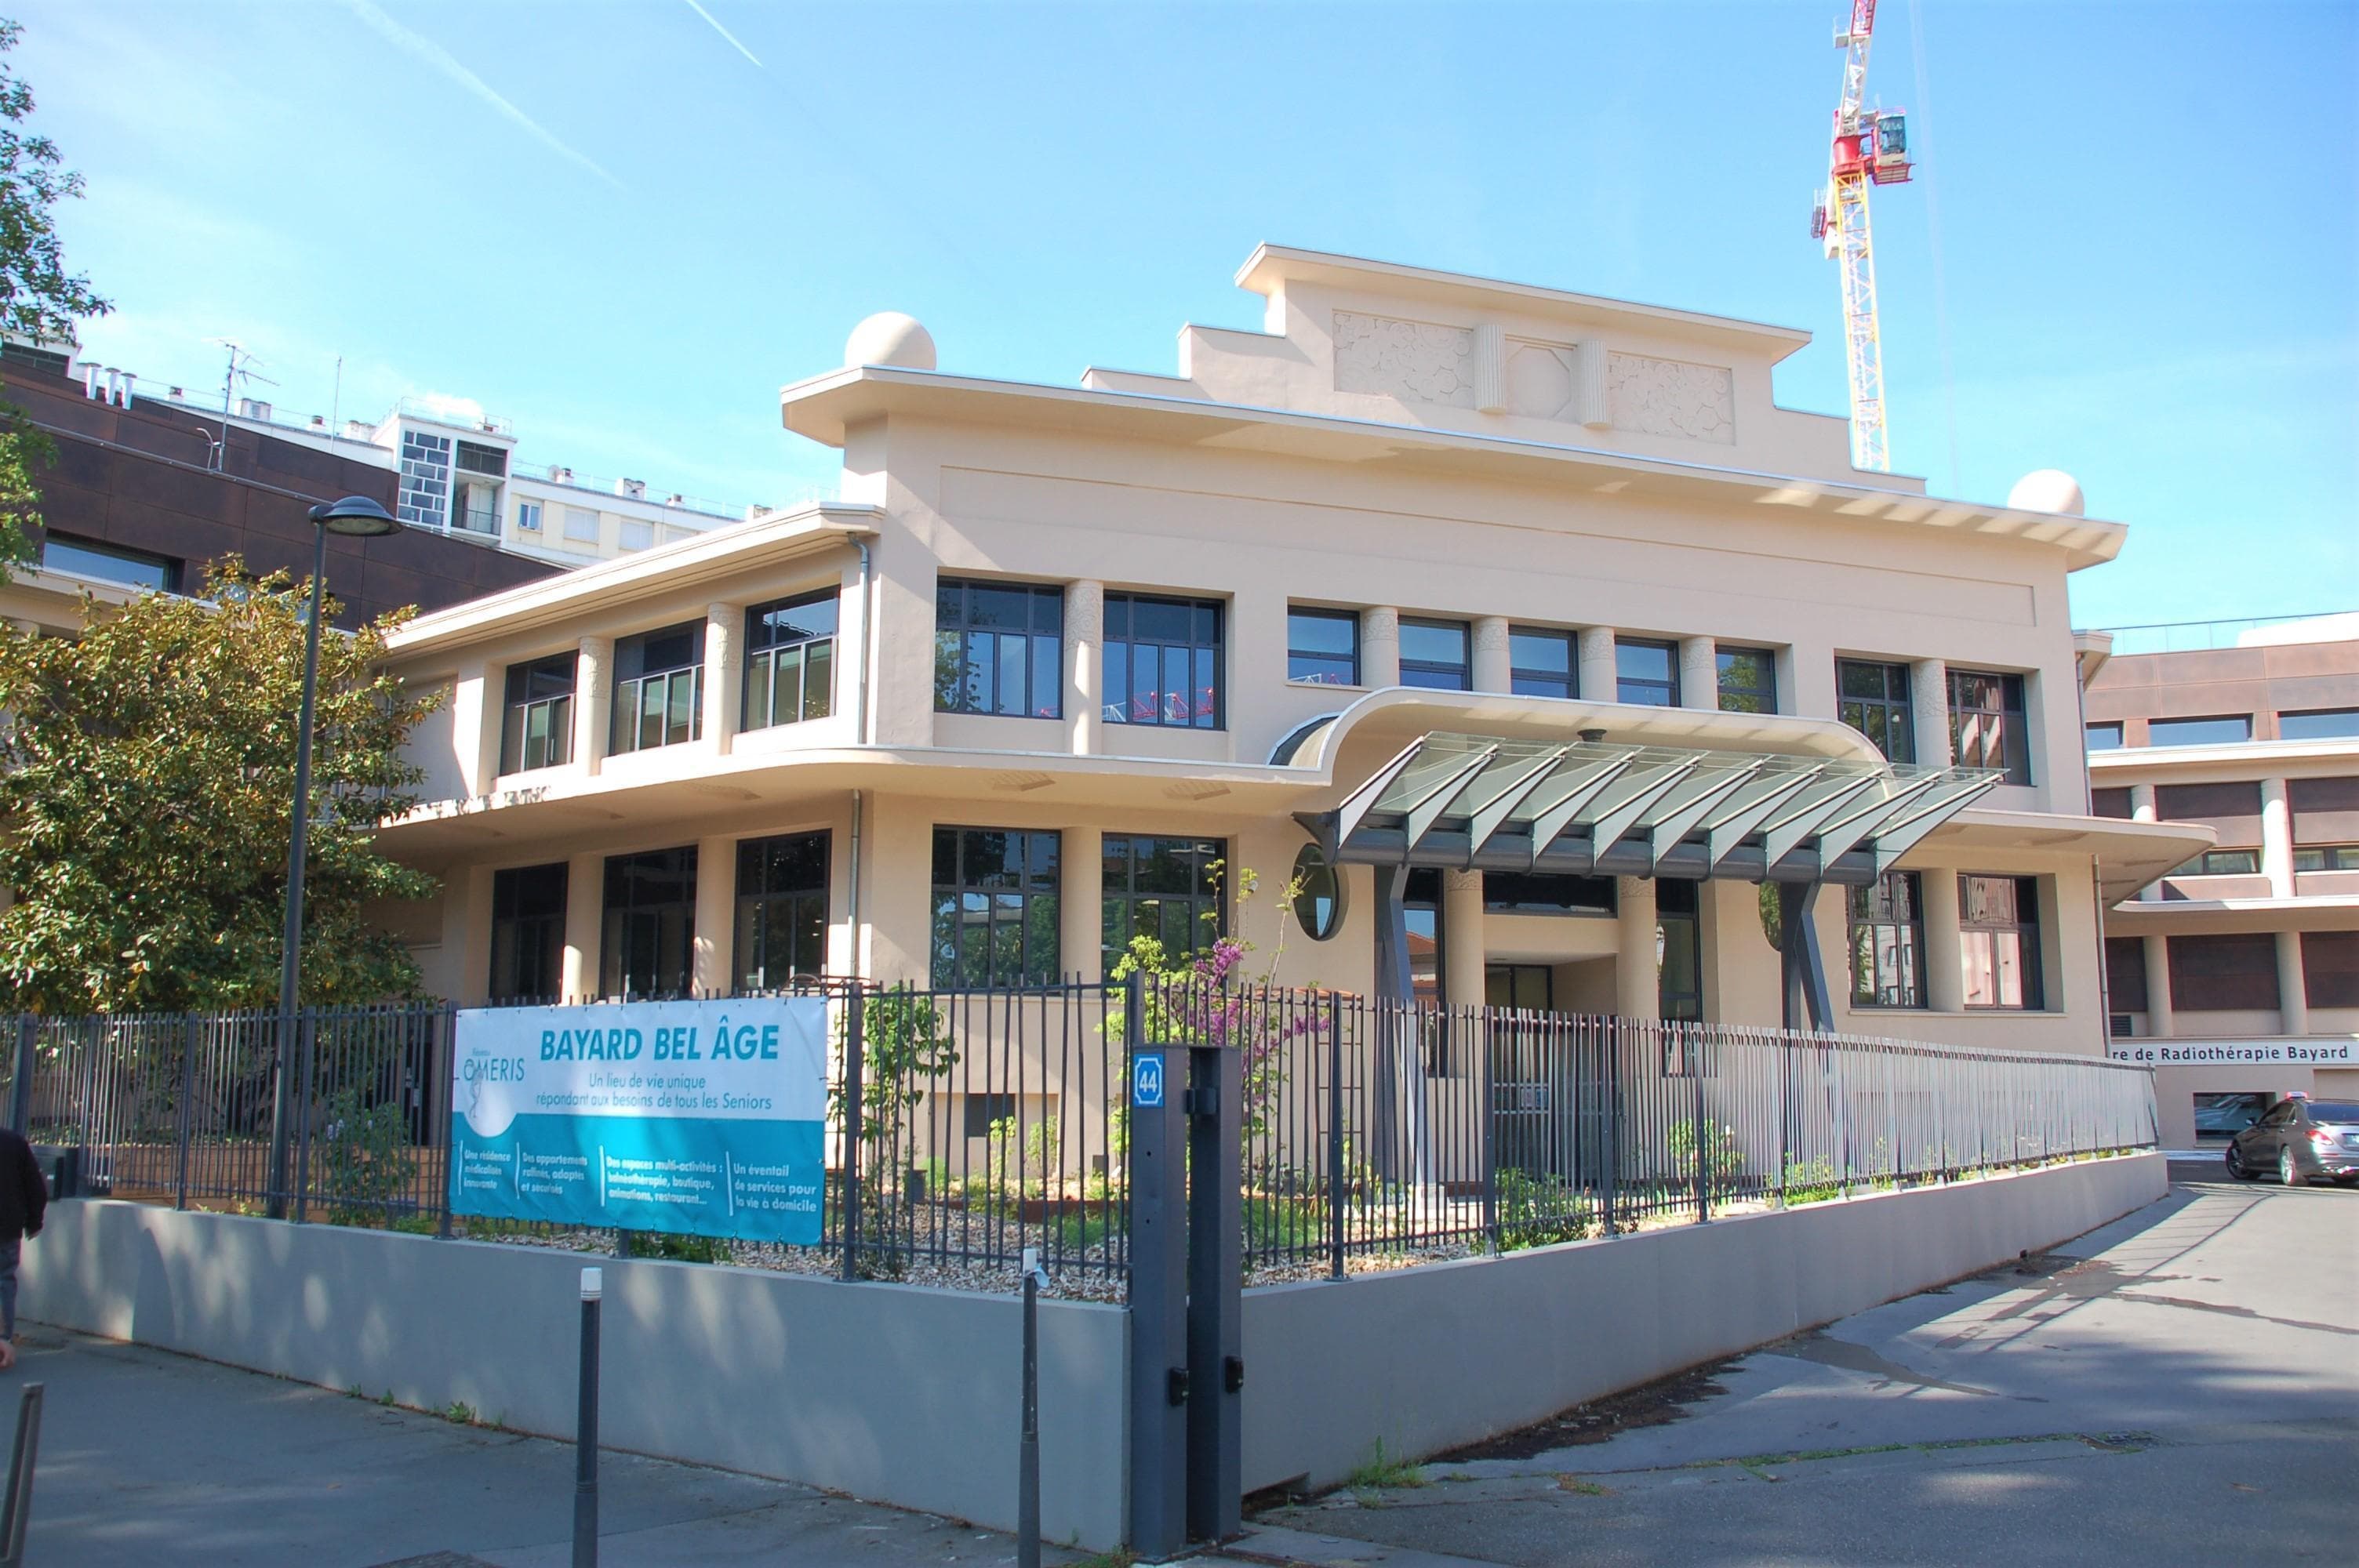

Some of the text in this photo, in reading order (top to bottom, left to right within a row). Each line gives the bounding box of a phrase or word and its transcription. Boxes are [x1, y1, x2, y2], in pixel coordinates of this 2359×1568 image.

[540, 1014, 780, 1061] BAYARD BEL ÂGE
[2135, 1048, 2154, 1060] de
[2161, 1045, 2280, 1062] Radiothérapie
[2288, 1045, 2348, 1062] Bayard
[463, 1058, 525, 1082] OMERIS
[589, 1073, 706, 1091] Un lieu de vie unique
[1139, 1070, 1158, 1093] 44
[536, 1091, 772, 1109] répondant aux besoins de tous les Seniors
[733, 1163, 790, 1177] Un éventail
[521, 1182, 529, 1192] et
[672, 1176, 714, 1190] boutique,
[735, 1178, 816, 1196] de services pour
[736, 1194, 744, 1207] la
[747, 1196, 759, 1208] vie
[772, 1198, 816, 1211] domicile
